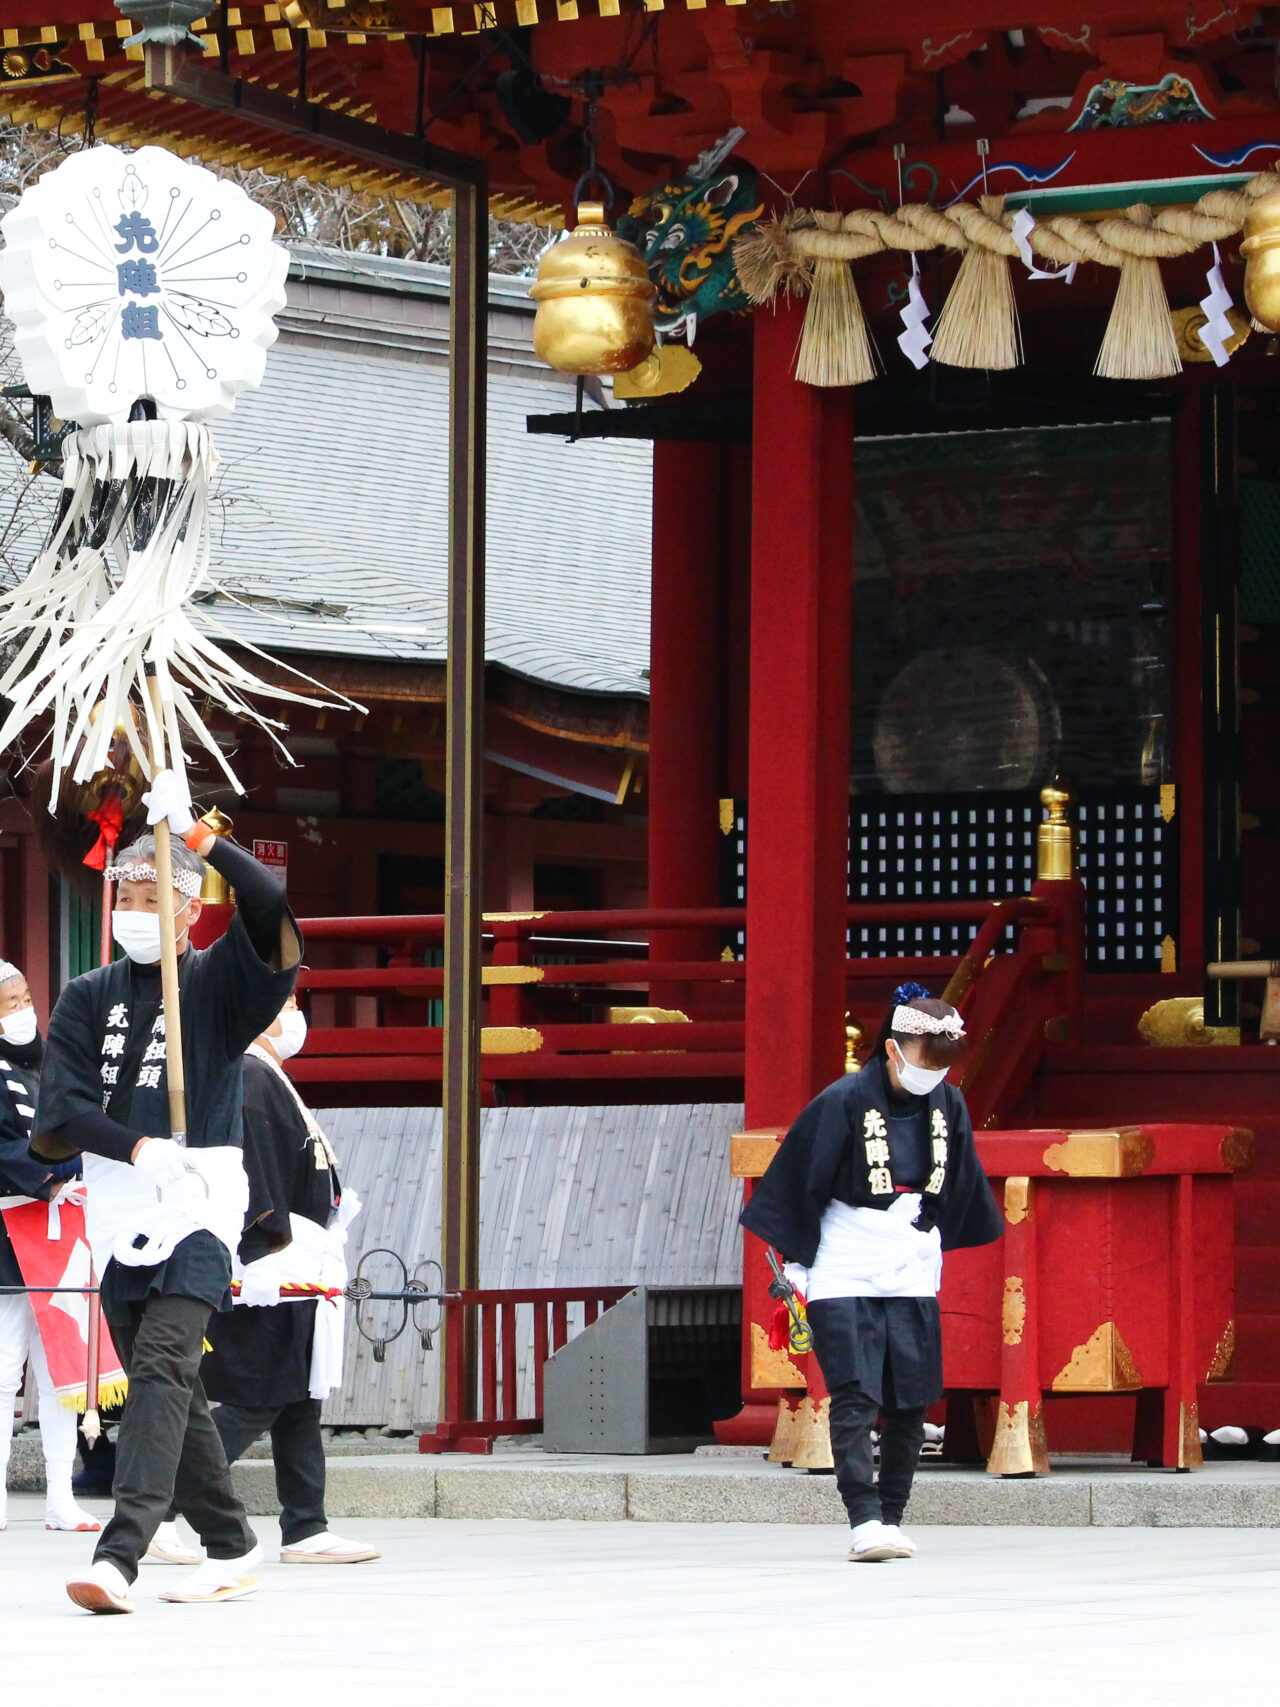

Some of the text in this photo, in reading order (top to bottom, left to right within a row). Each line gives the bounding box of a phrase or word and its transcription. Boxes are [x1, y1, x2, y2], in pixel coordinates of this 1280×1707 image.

[113, 210, 163, 341] 先陣組
[135, 997, 168, 1089] 陣組頭
[863, 1108, 894, 1195] 先陣組
[924, 1108, 949, 1195] 先陣組
